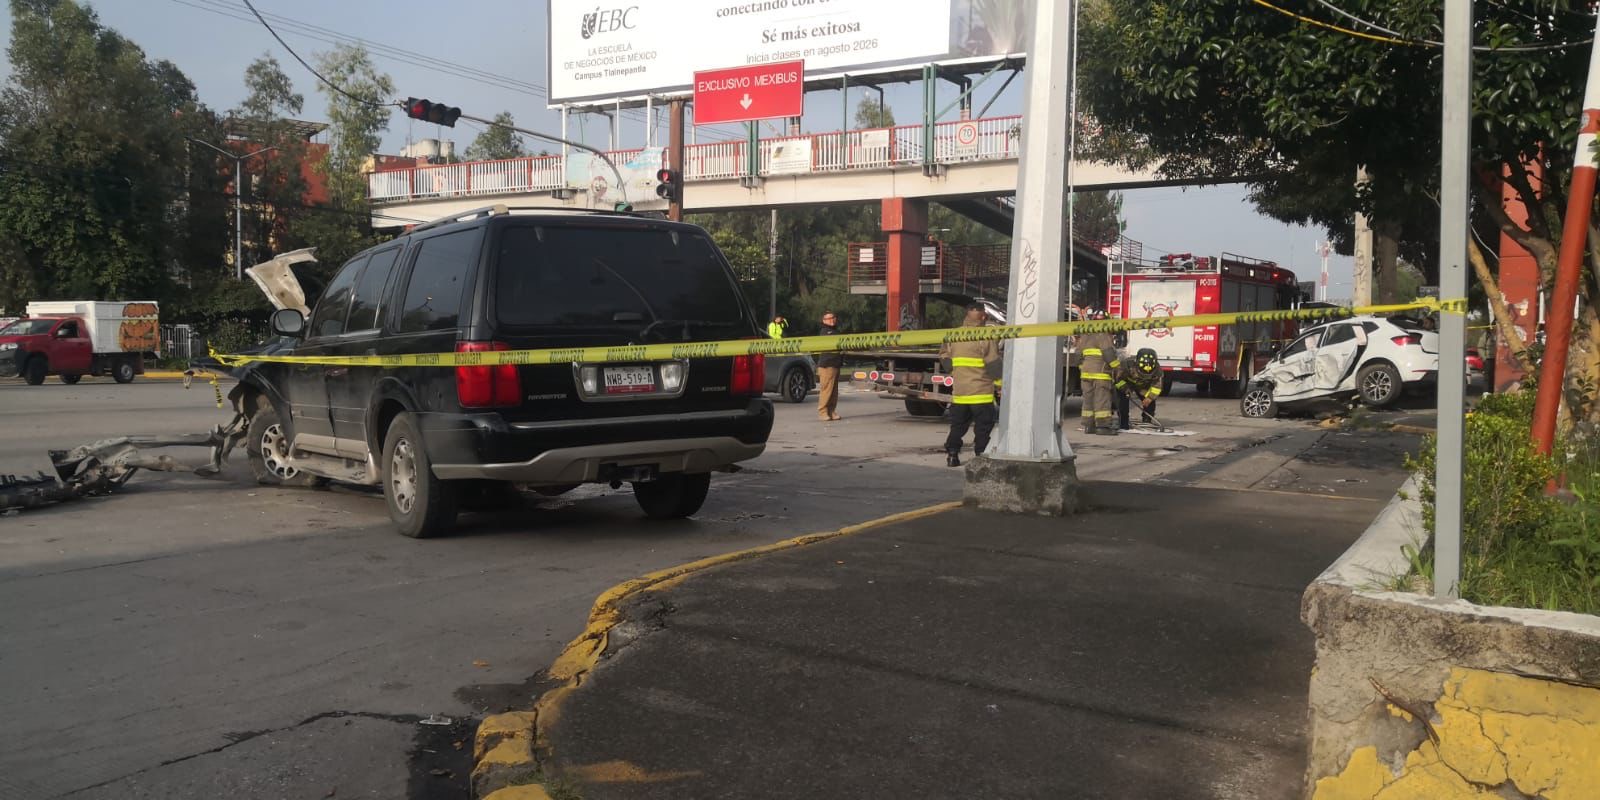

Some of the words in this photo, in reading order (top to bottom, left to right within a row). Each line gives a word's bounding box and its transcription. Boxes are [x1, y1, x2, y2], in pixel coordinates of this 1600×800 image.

[716, 0, 788, 18] conectando
[598, 6, 639, 33] EBC
[761, 29, 777, 44] Sé
[781, 26, 808, 41] más
[811, 21, 861, 38] exitosa
[588, 48, 597, 56] LA
[598, 42, 632, 55] ESCUELA
[746, 53, 770, 64] Inicia
[771, 50, 801, 61] clases
[803, 49, 816, 57] en
[817, 45, 851, 57] agosto
[853, 38, 878, 50] 2026
[564, 62, 575, 70] DE
[575, 56, 614, 68] NEGOCIOS
[615, 54, 626, 64] DE
[574, 71, 602, 80] Campus
[698, 76, 750, 92] EXCLUSIVO
[754, 71, 798, 87] MEXIBUS
[606, 372, 653, 385] NWB-519-A
